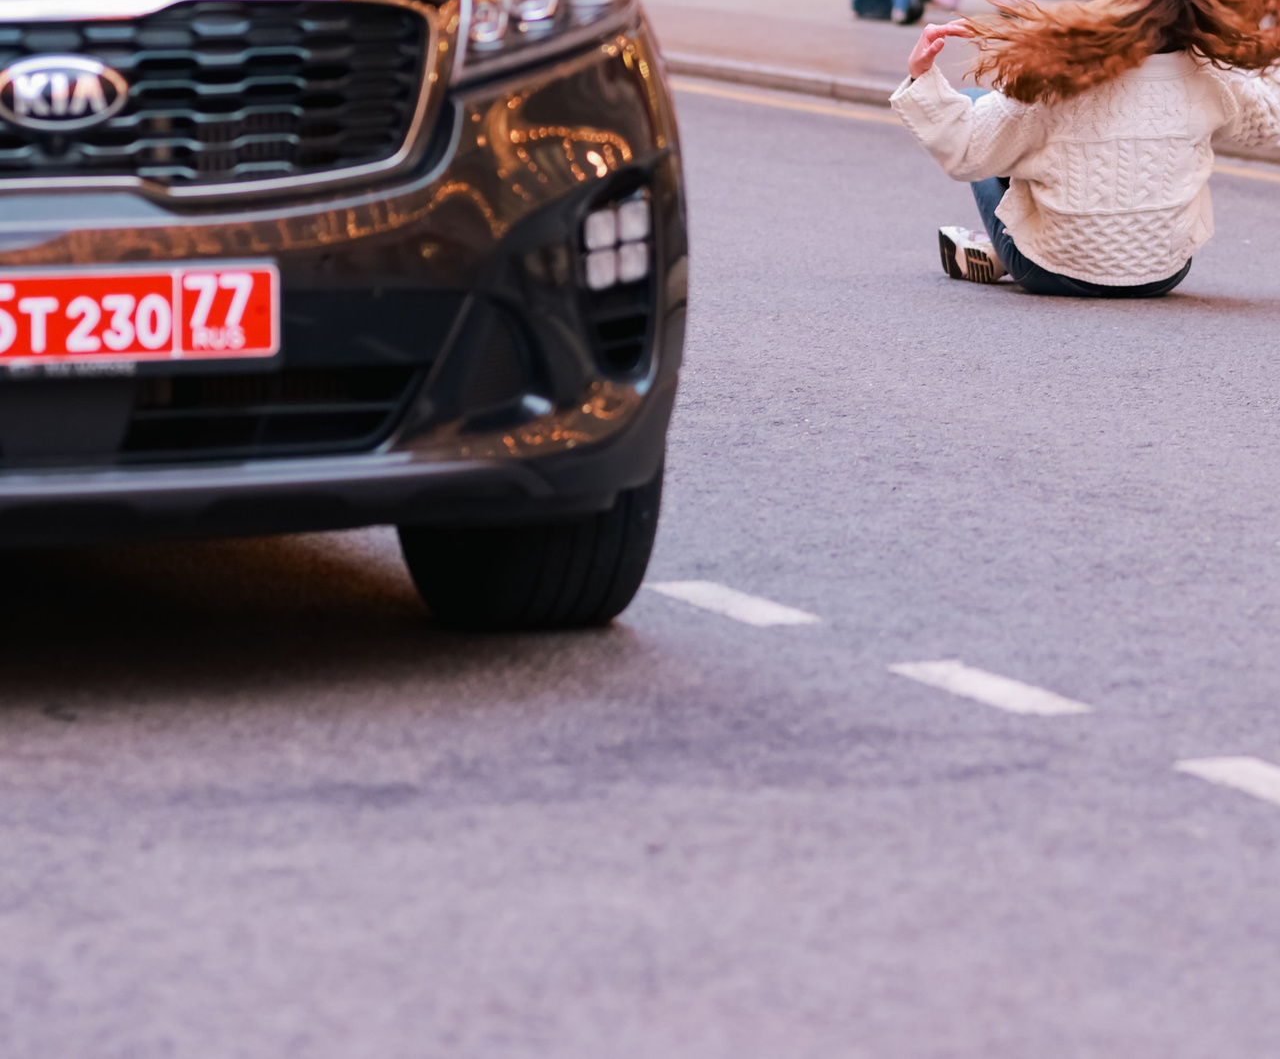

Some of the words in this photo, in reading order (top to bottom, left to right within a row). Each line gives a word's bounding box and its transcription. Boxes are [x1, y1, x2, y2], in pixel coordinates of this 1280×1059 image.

[12, 72, 109, 116] KIA
[183, 273, 254, 331] 77
[191, 326, 246, 350] RUS
